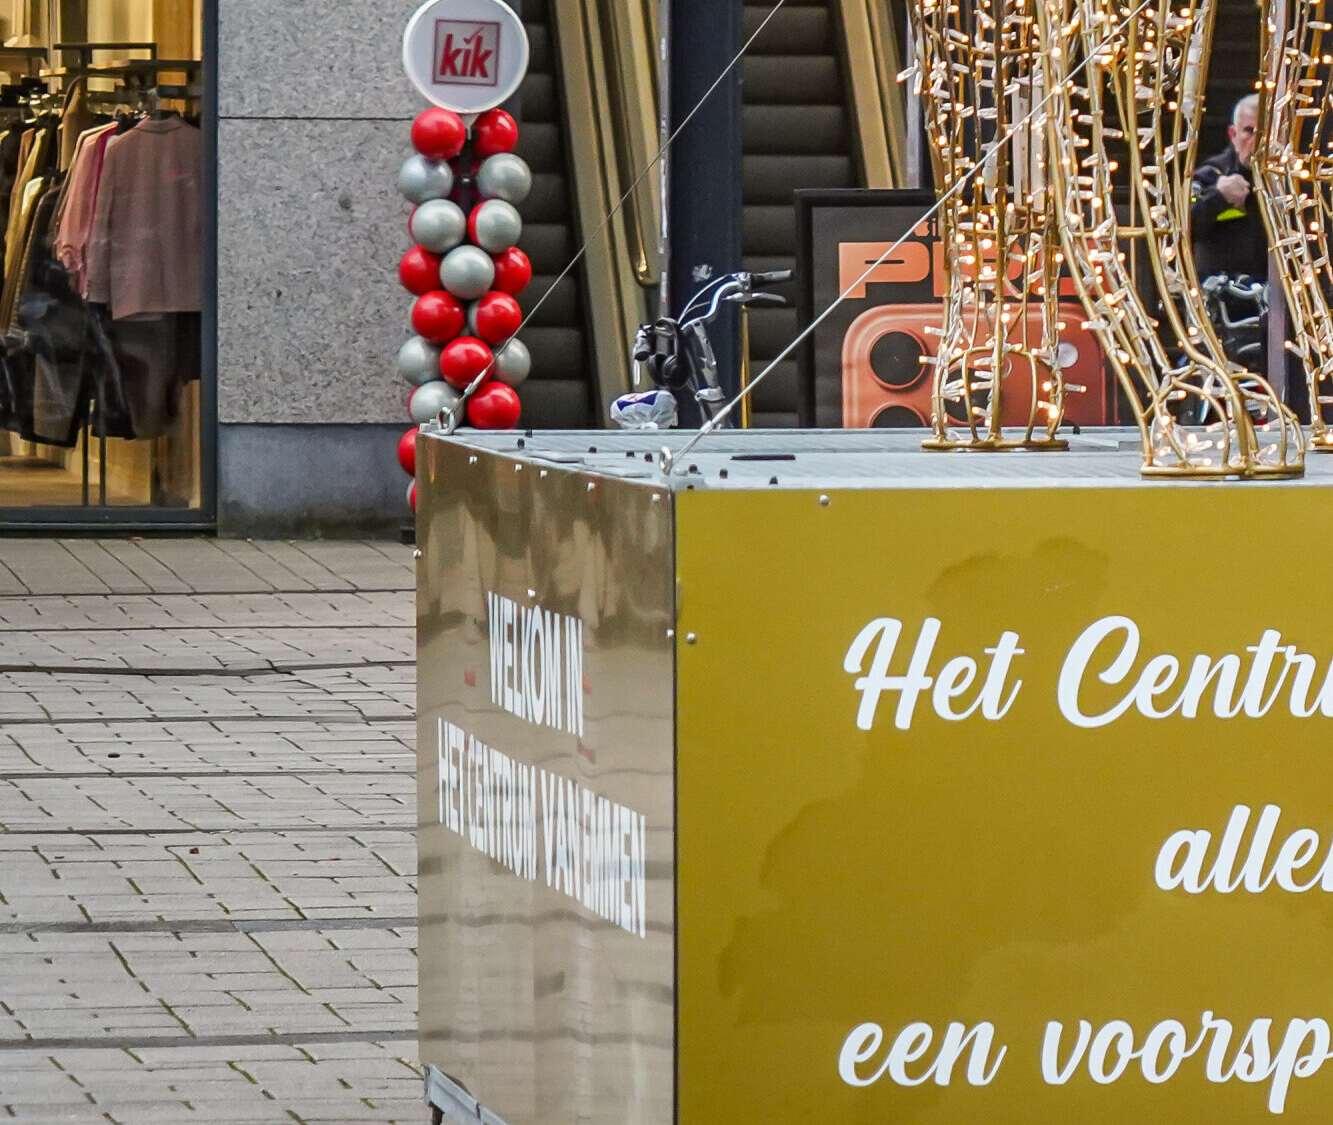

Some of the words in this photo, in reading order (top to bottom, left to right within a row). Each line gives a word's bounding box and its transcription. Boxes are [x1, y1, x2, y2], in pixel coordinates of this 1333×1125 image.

[440, 26, 494, 78] kik
[487, 590, 562, 731] WELKOM
[565, 614, 584, 738] IN
[843, 616, 1025, 730] Het
[437, 717, 465, 836] HET
[468, 734, 537, 881] CENTRUM
[541, 768, 581, 902] VAN
[583, 787, 646, 939] EMMEN
[838, 1019, 1008, 1087] een
